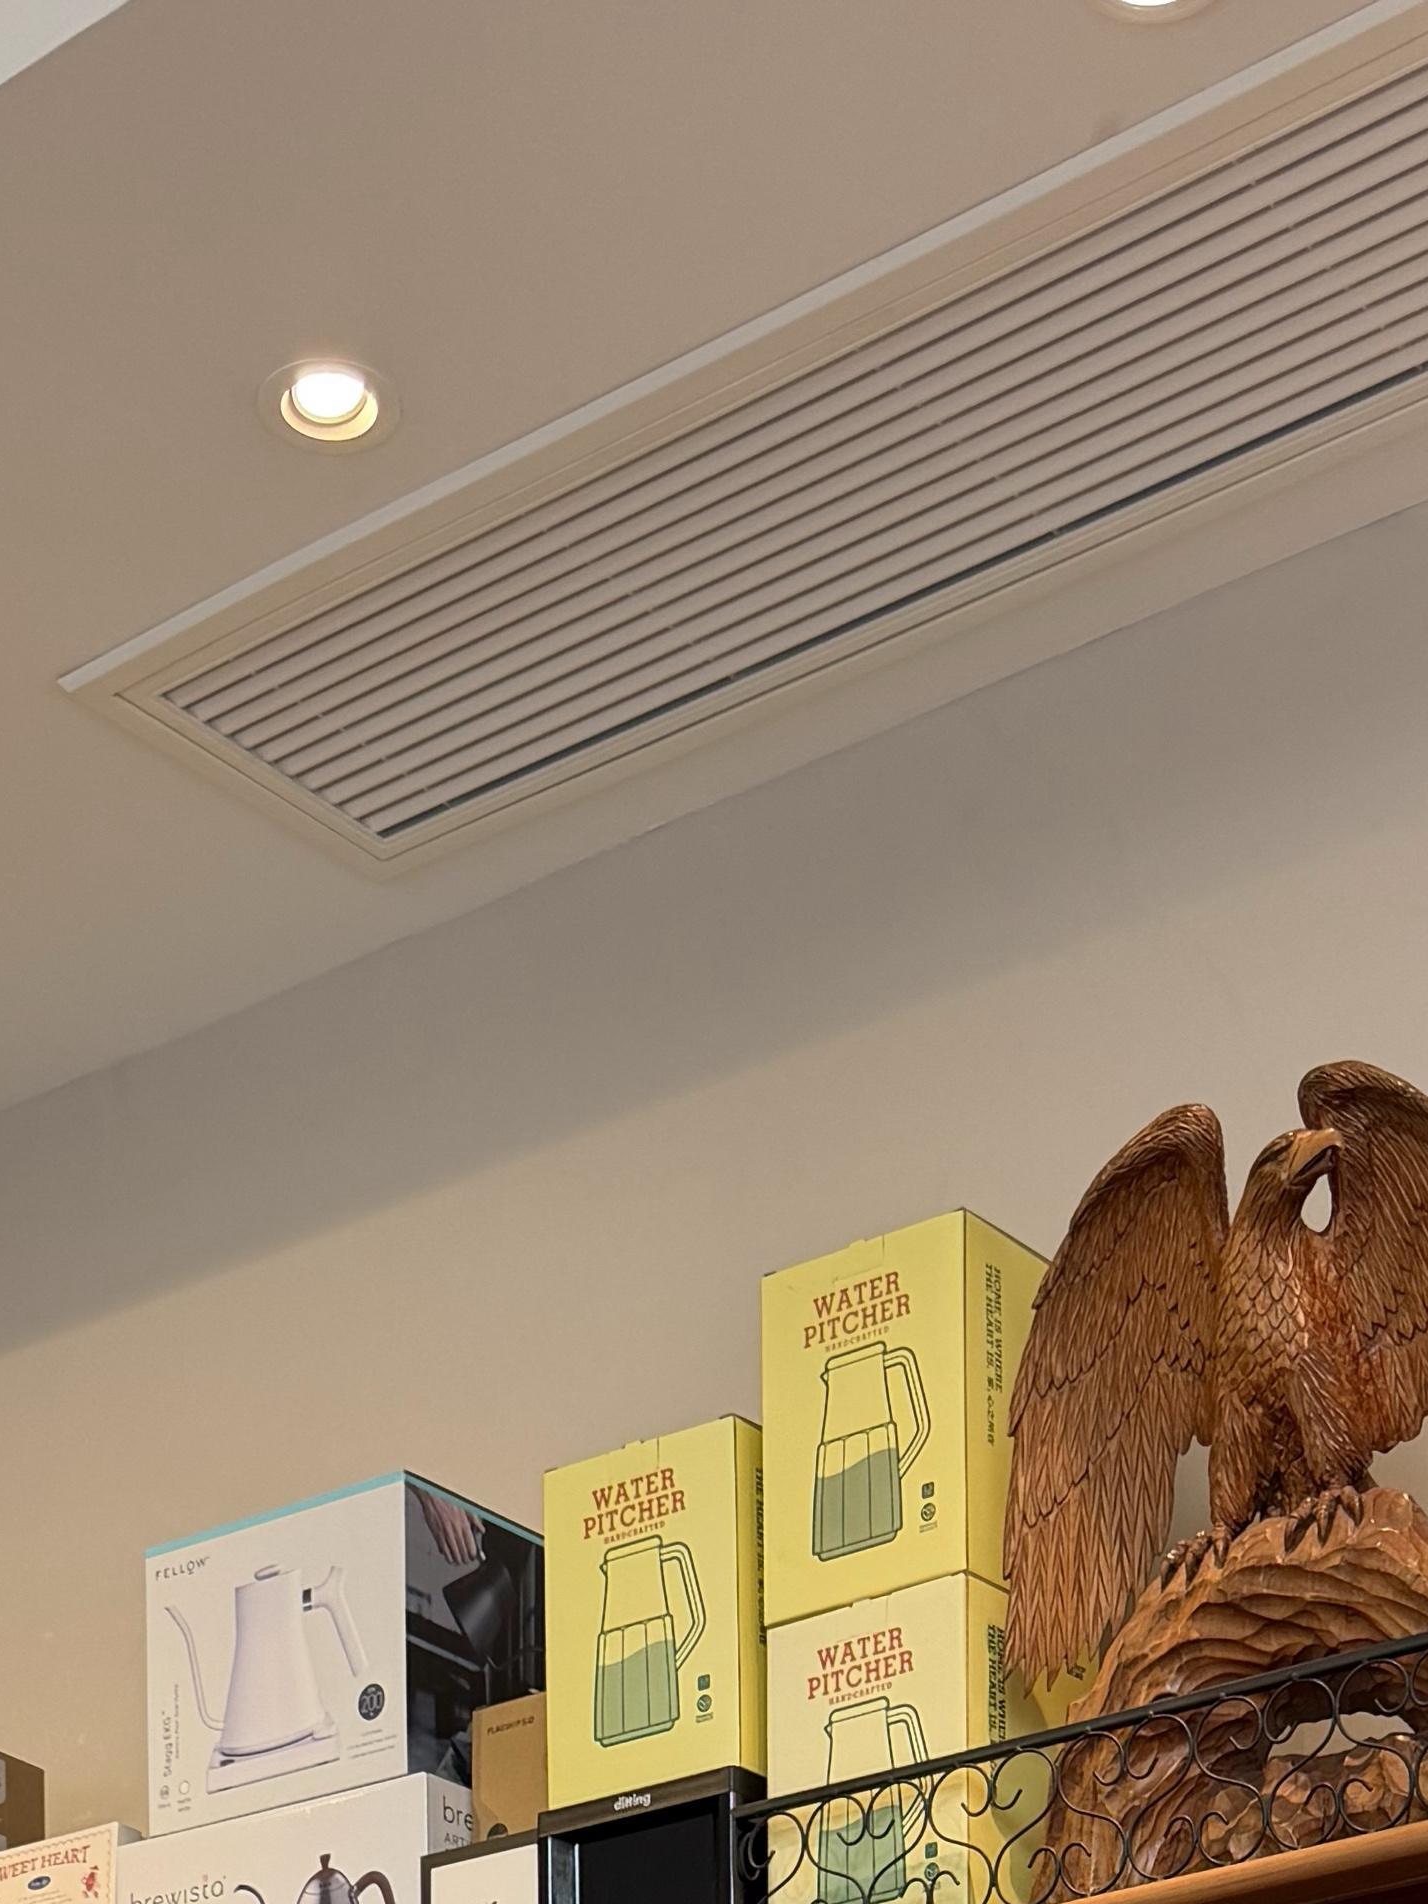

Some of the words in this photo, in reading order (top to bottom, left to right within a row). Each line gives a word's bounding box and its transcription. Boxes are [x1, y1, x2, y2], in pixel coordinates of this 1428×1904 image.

[813, 1271, 900, 1319] WATER
[803, 1293, 911, 1349] PITCHER
[592, 1467, 676, 1511] WATER
[583, 1489, 686, 1540] PITCHER
[603, 1520, 666, 1545] HANDCRAFTED
[155, 1556, 208, 1581] FELLOW
[817, 1626, 904, 1671] WATER
[807, 1649, 915, 1700] PITCHER
[828, 1681, 893, 1706] HANDCRAFTED
[361, 1691, 384, 1714] 200
[40, 1845, 91, 1869] HEART
